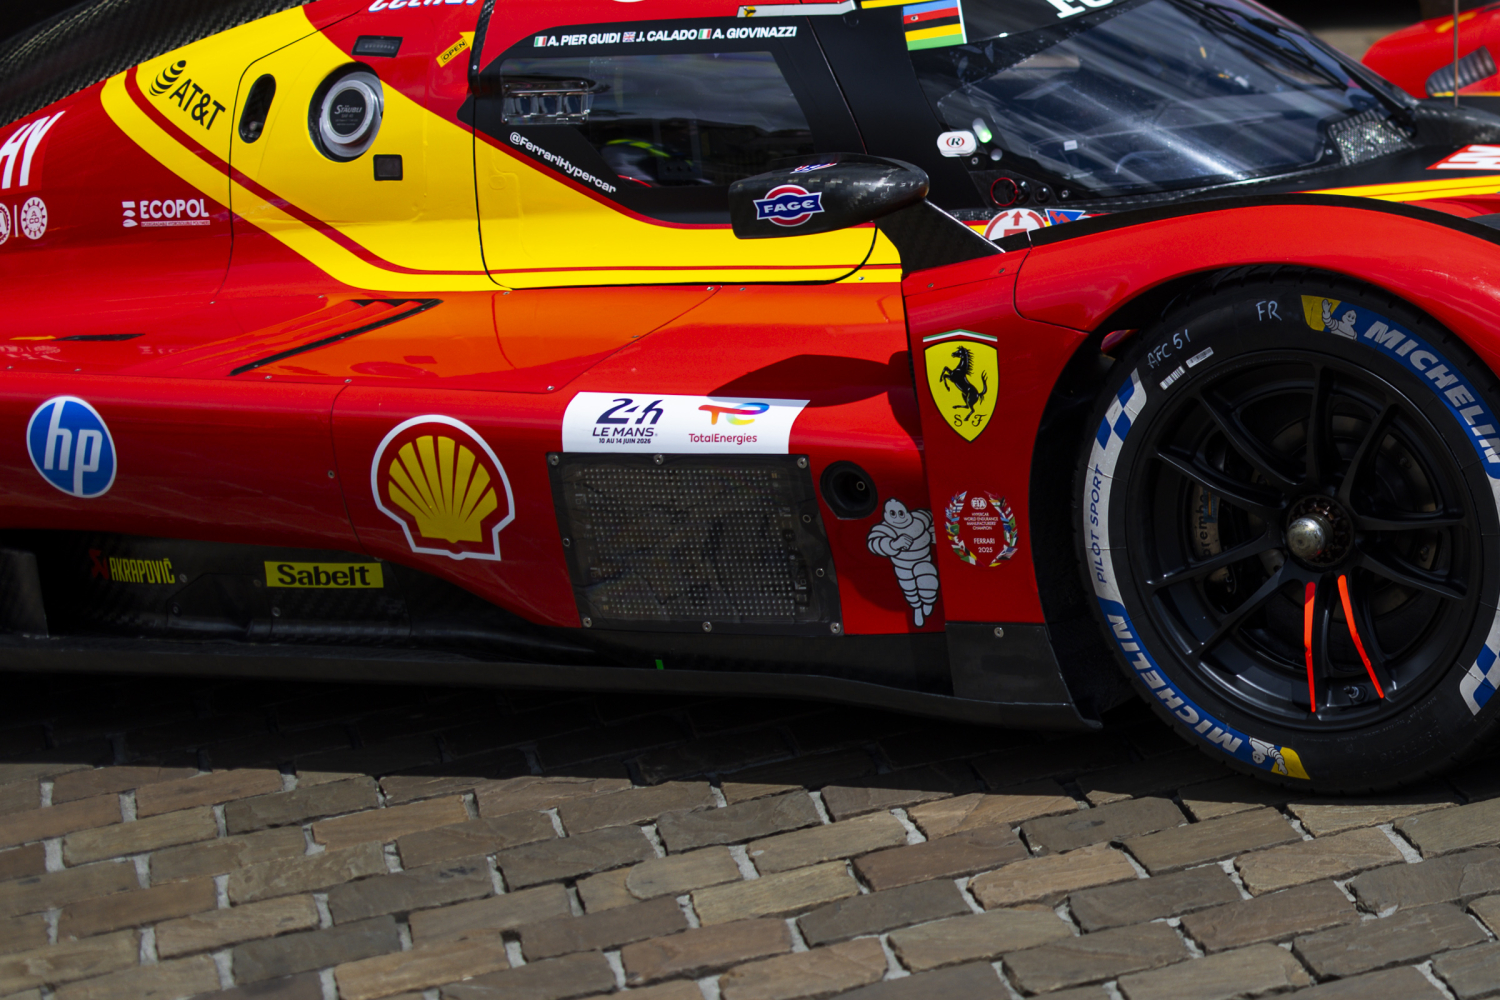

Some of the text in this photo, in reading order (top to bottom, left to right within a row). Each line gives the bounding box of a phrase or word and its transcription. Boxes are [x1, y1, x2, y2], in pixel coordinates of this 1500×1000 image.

[547, 26, 798, 46] A. PIER GUIDI J. CALADO A. GIOVINAZZI
[443, 41, 466, 60] OPEN
[169, 78, 227, 131] AT&T
[509, 132, 617, 194] @FerrariHypercar
[140, 198, 210, 219] ECOPOL
[763, 200, 815, 215] FAGE
[1256, 300, 1282, 321] FR
[1147, 342, 1172, 369] AFC
[1172, 329, 1191, 350] 51
[595, 398, 664, 425] 24h
[953, 412, 988, 428] S F
[592, 427, 655, 437] LE MANS
[689, 433, 758, 445] TotalEnergies
[44, 400, 102, 496] hp
[1090, 465, 1107, 584] PILOT SPORT
[109, 557, 175, 584] AKRAPOVIČ
[278, 563, 370, 587] Sabelt
[1107, 614, 1242, 754] MICHELIN
